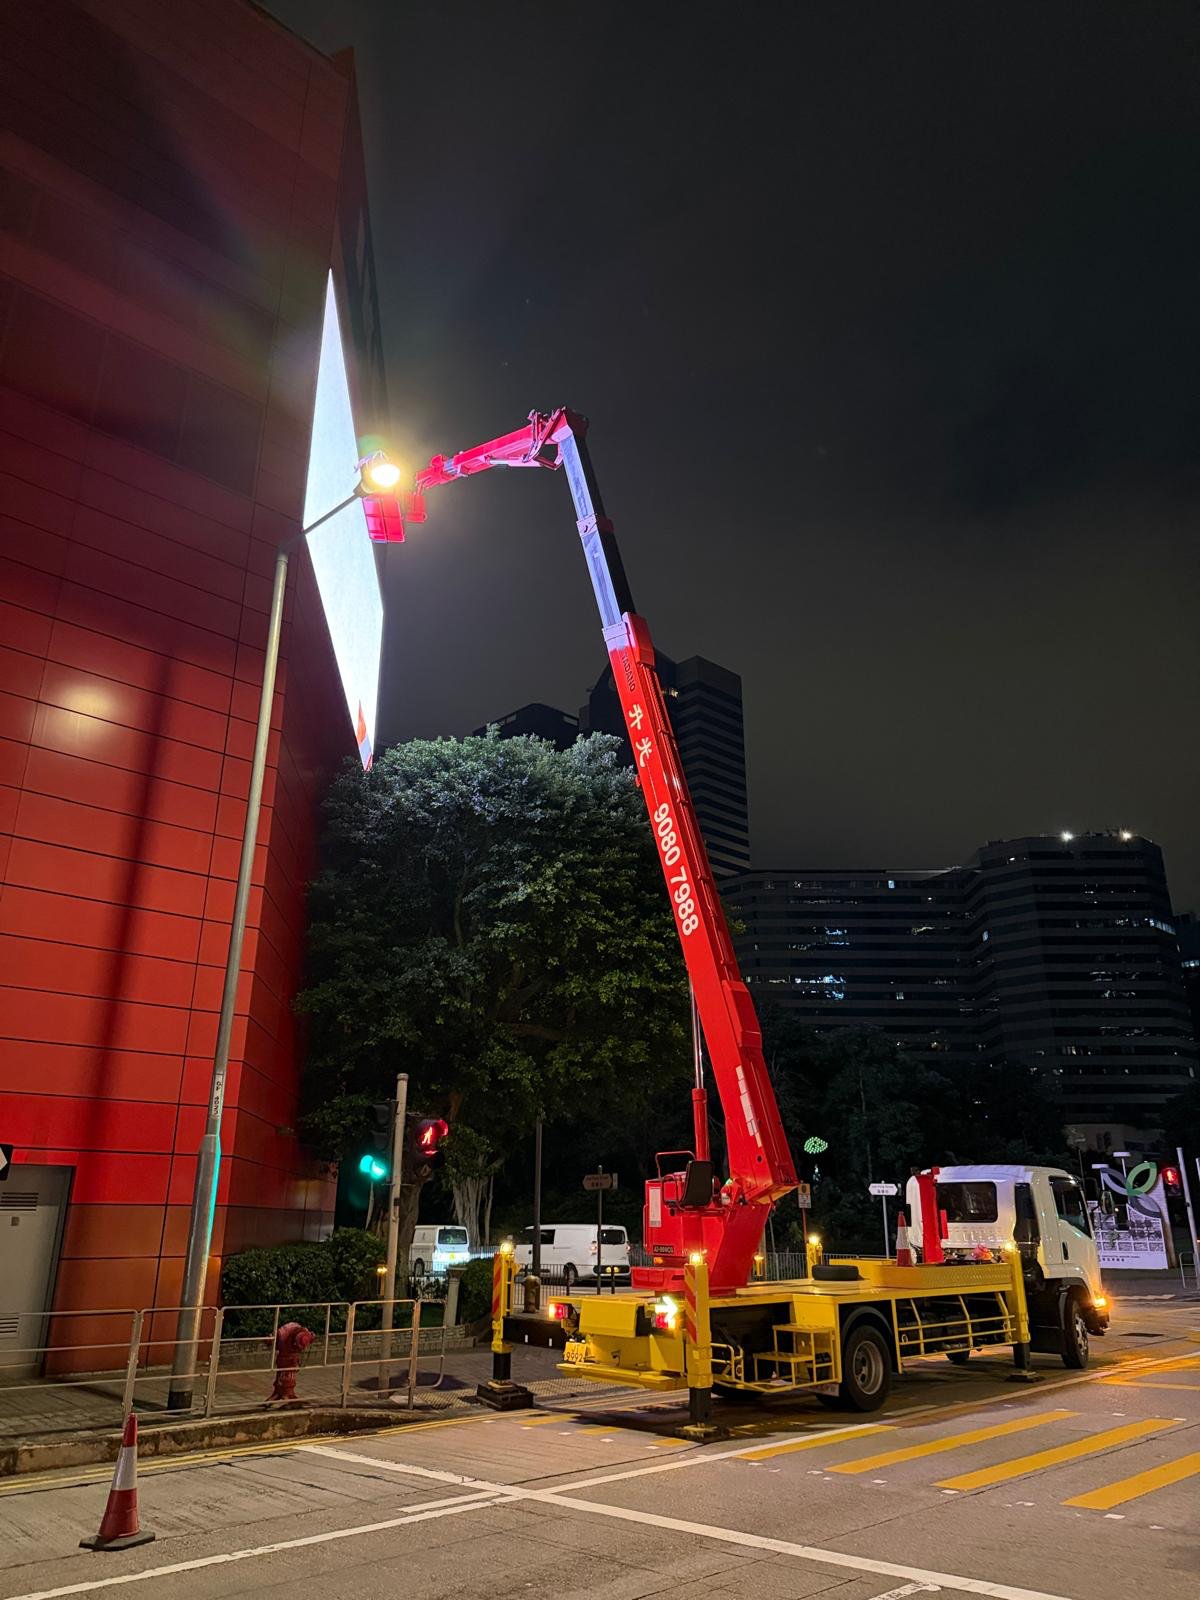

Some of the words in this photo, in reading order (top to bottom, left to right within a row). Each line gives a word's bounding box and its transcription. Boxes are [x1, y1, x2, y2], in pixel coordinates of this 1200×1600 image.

[620, 653, 636, 693] TADANO
[628, 703, 652, 768] 升光
[653, 803, 681, 866] 9080
[670, 866, 699, 936] 7988
